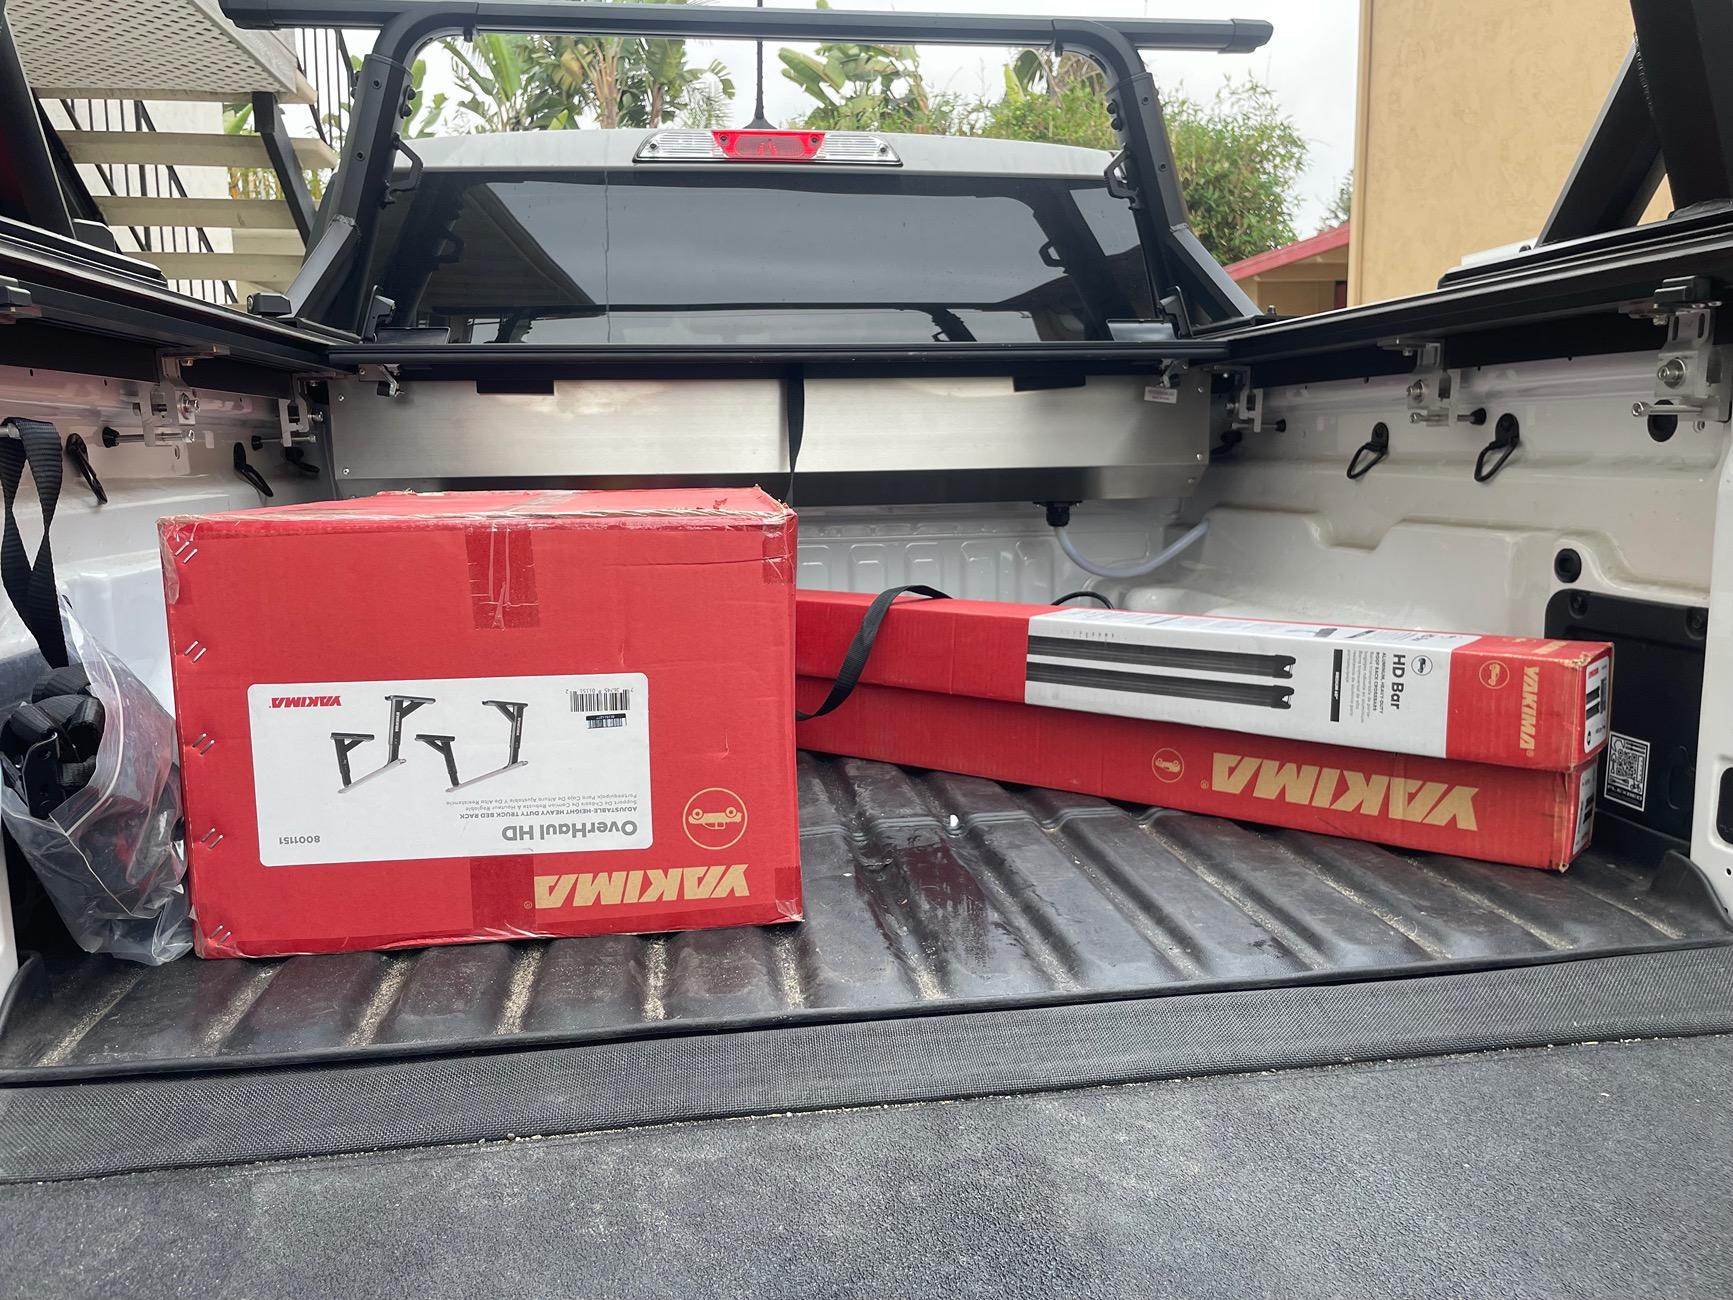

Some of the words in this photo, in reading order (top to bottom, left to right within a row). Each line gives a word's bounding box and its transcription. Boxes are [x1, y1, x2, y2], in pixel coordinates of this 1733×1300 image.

[1393, 654, 1406, 678] HD
[272, 696, 341, 708] YAKIMA
[1391, 682, 1404, 709] Bar
[1520, 666, 1539, 749] YAKIMA
[1212, 752, 1479, 831] YAKIMA
[566, 806, 638, 815] ADJUSTABLE-HEIGHT
[279, 835, 320, 845] 8001151
[501, 825, 534, 841] HD
[540, 820, 637, 840] OverHaul
[534, 864, 750, 908] YAKIMA
